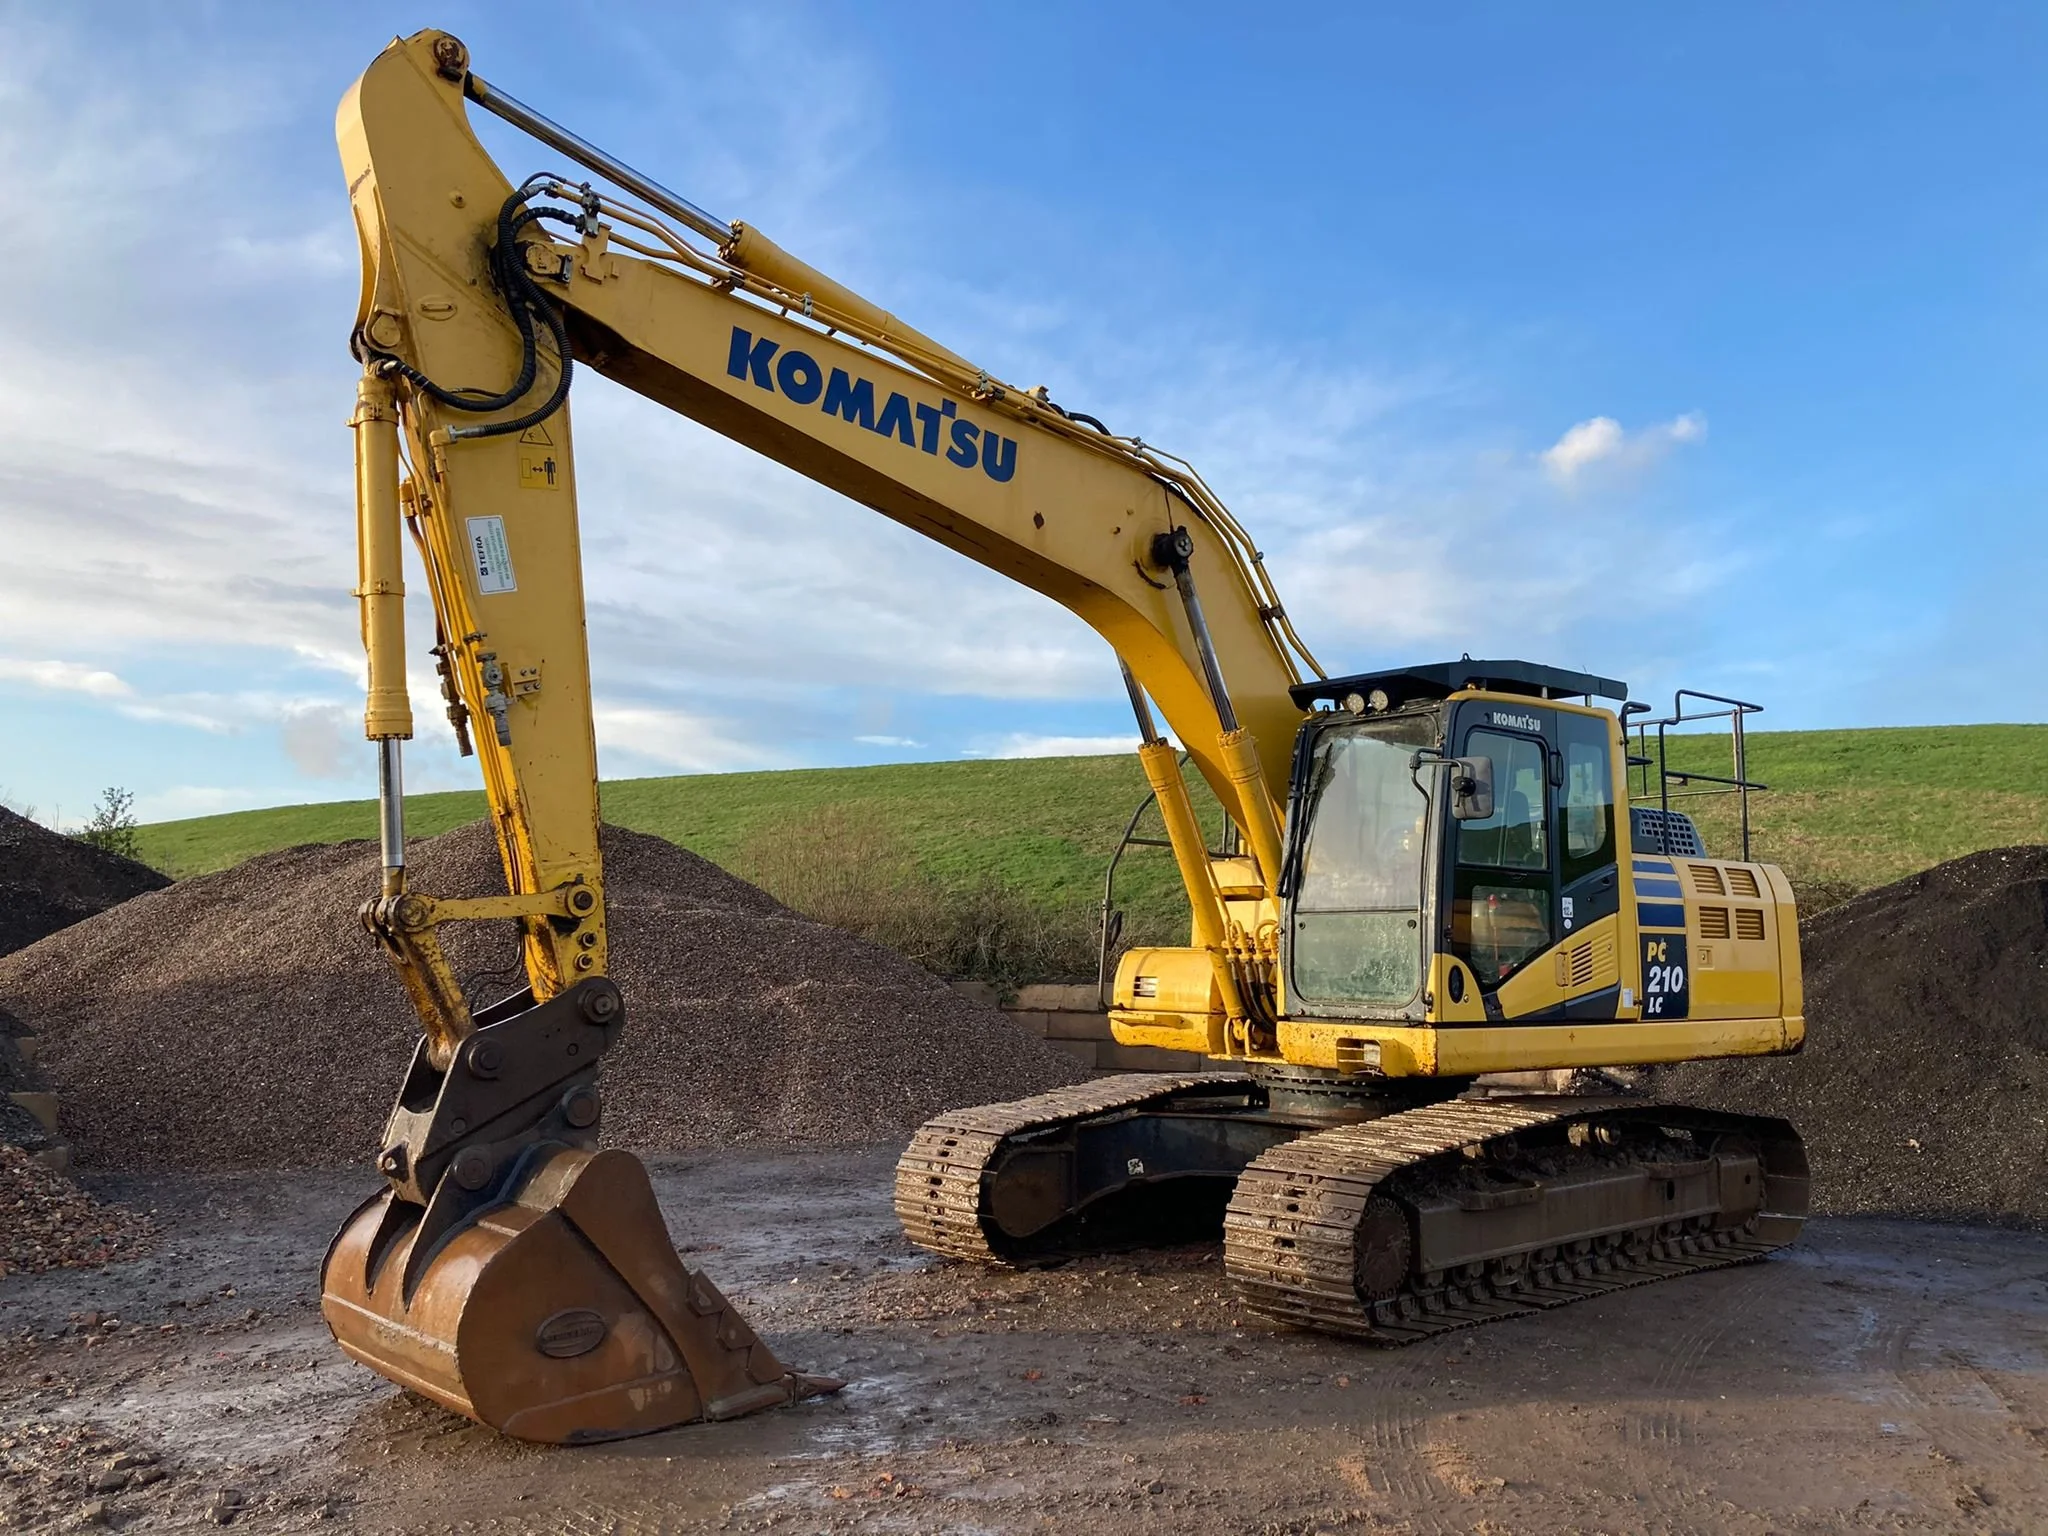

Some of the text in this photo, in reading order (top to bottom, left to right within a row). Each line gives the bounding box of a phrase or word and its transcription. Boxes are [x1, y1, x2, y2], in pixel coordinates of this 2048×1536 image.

[727, 326, 1017, 483] KOMATSU
[475, 536, 487, 566] TEFRA
[1493, 711, 1541, 731] KOMATSU
[1647, 942, 1667, 962] PC
[1647, 966, 1684, 993] 210
[1648, 996, 1663, 1014] LC
